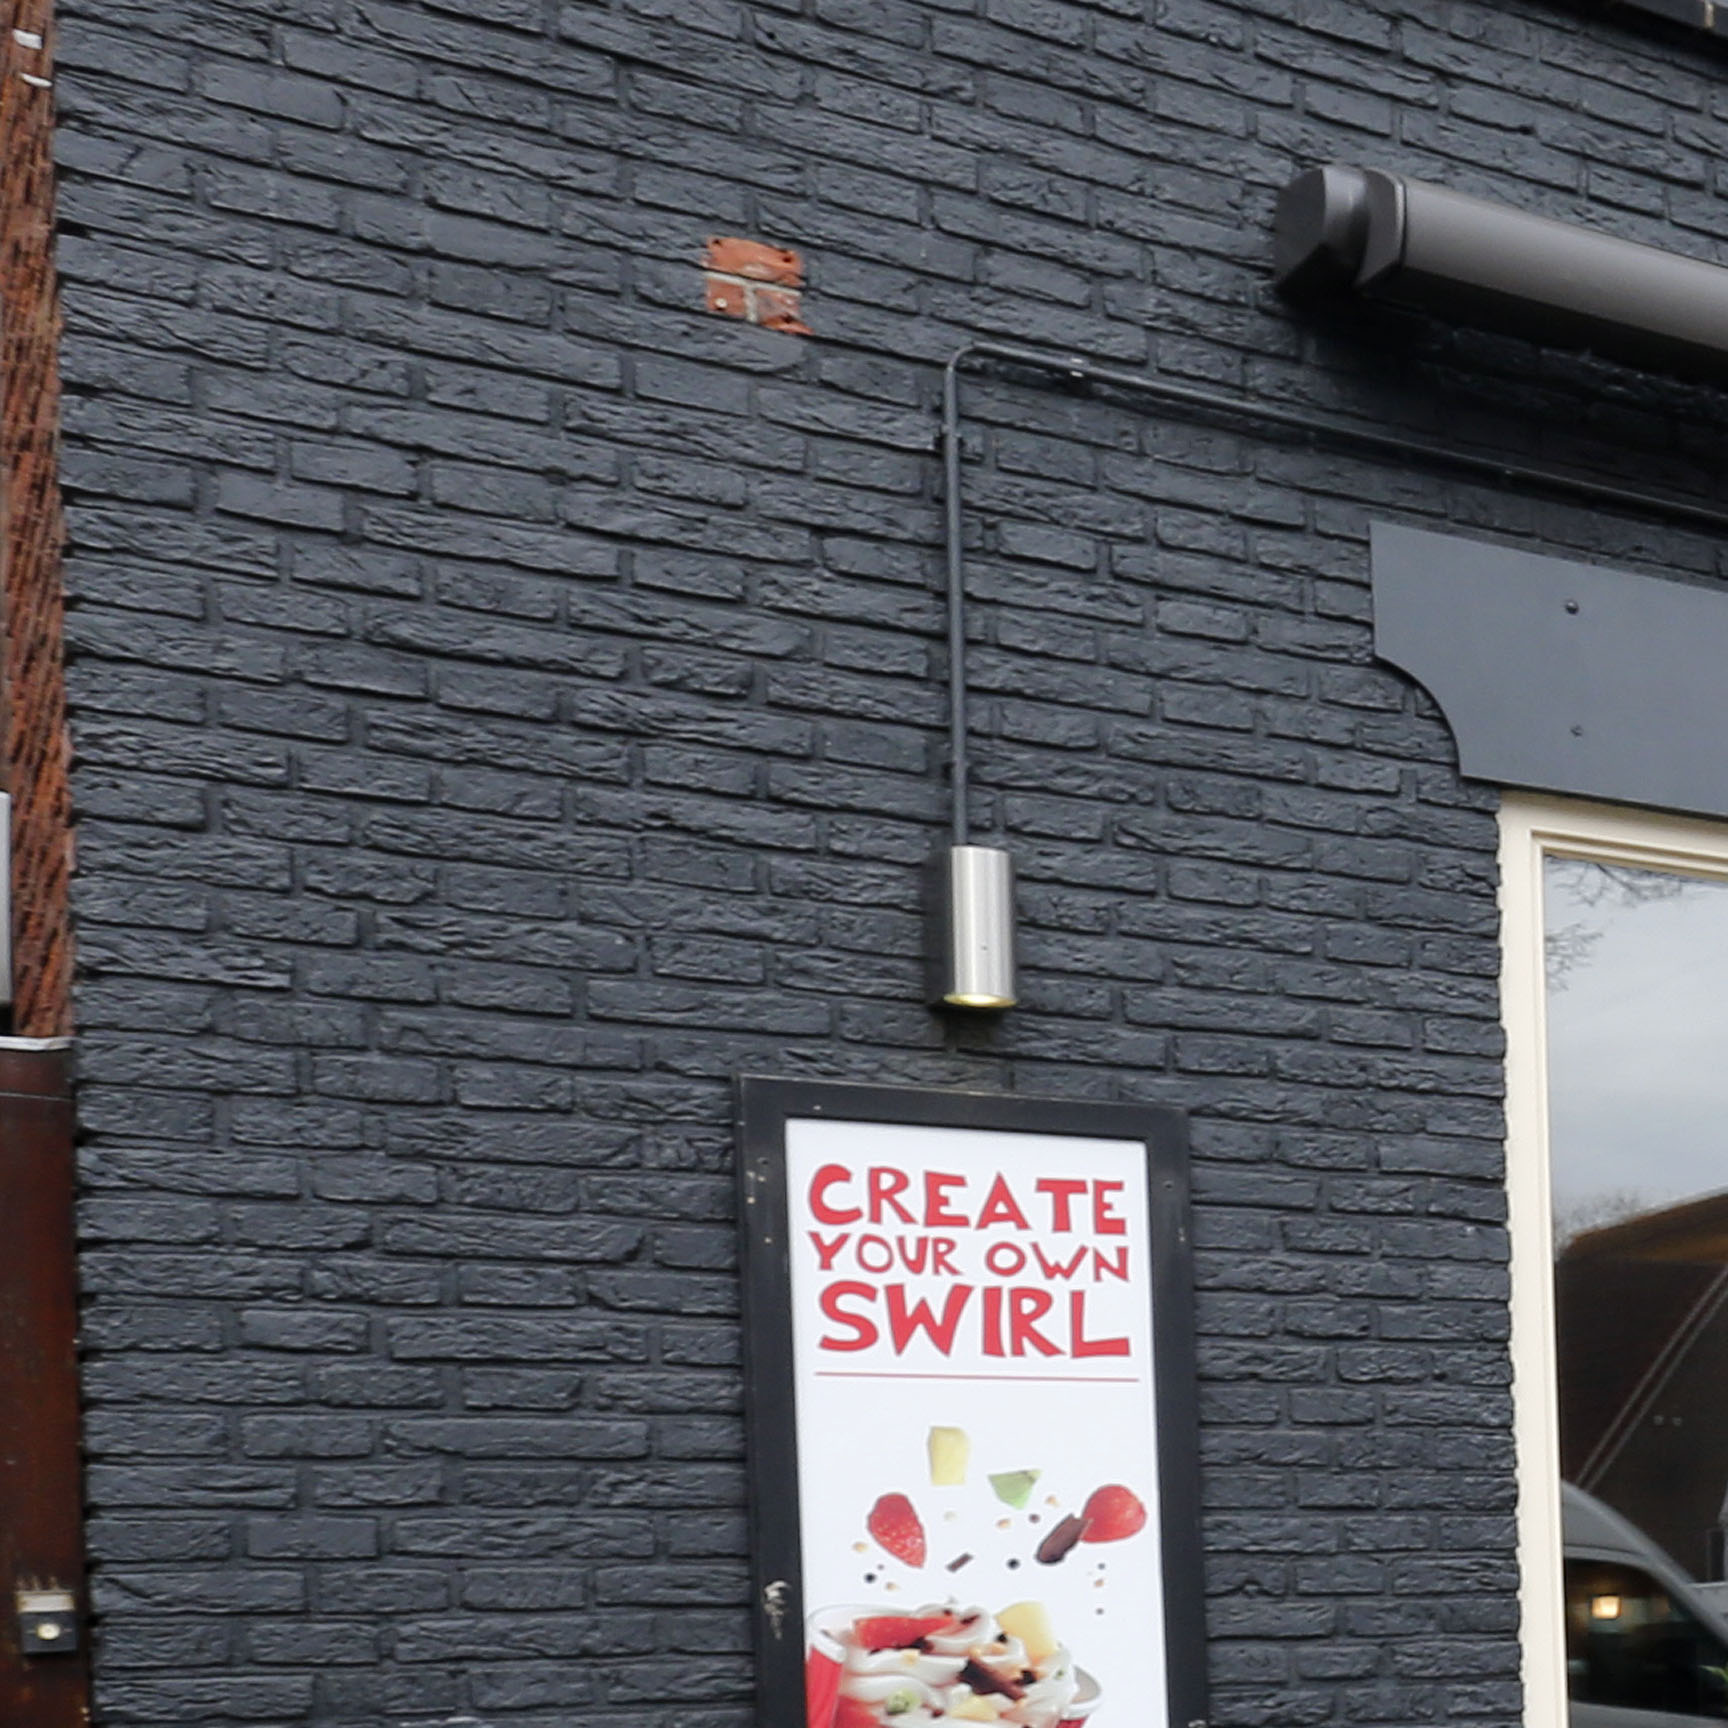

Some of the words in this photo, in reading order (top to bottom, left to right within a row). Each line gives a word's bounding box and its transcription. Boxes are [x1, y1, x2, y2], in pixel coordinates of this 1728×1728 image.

[807, 1163, 1127, 1236] CREATE
[807, 1230, 963, 1277] YOUR
[984, 1241, 1130, 1282] OWN
[818, 1279, 1132, 1359] SWIRL
